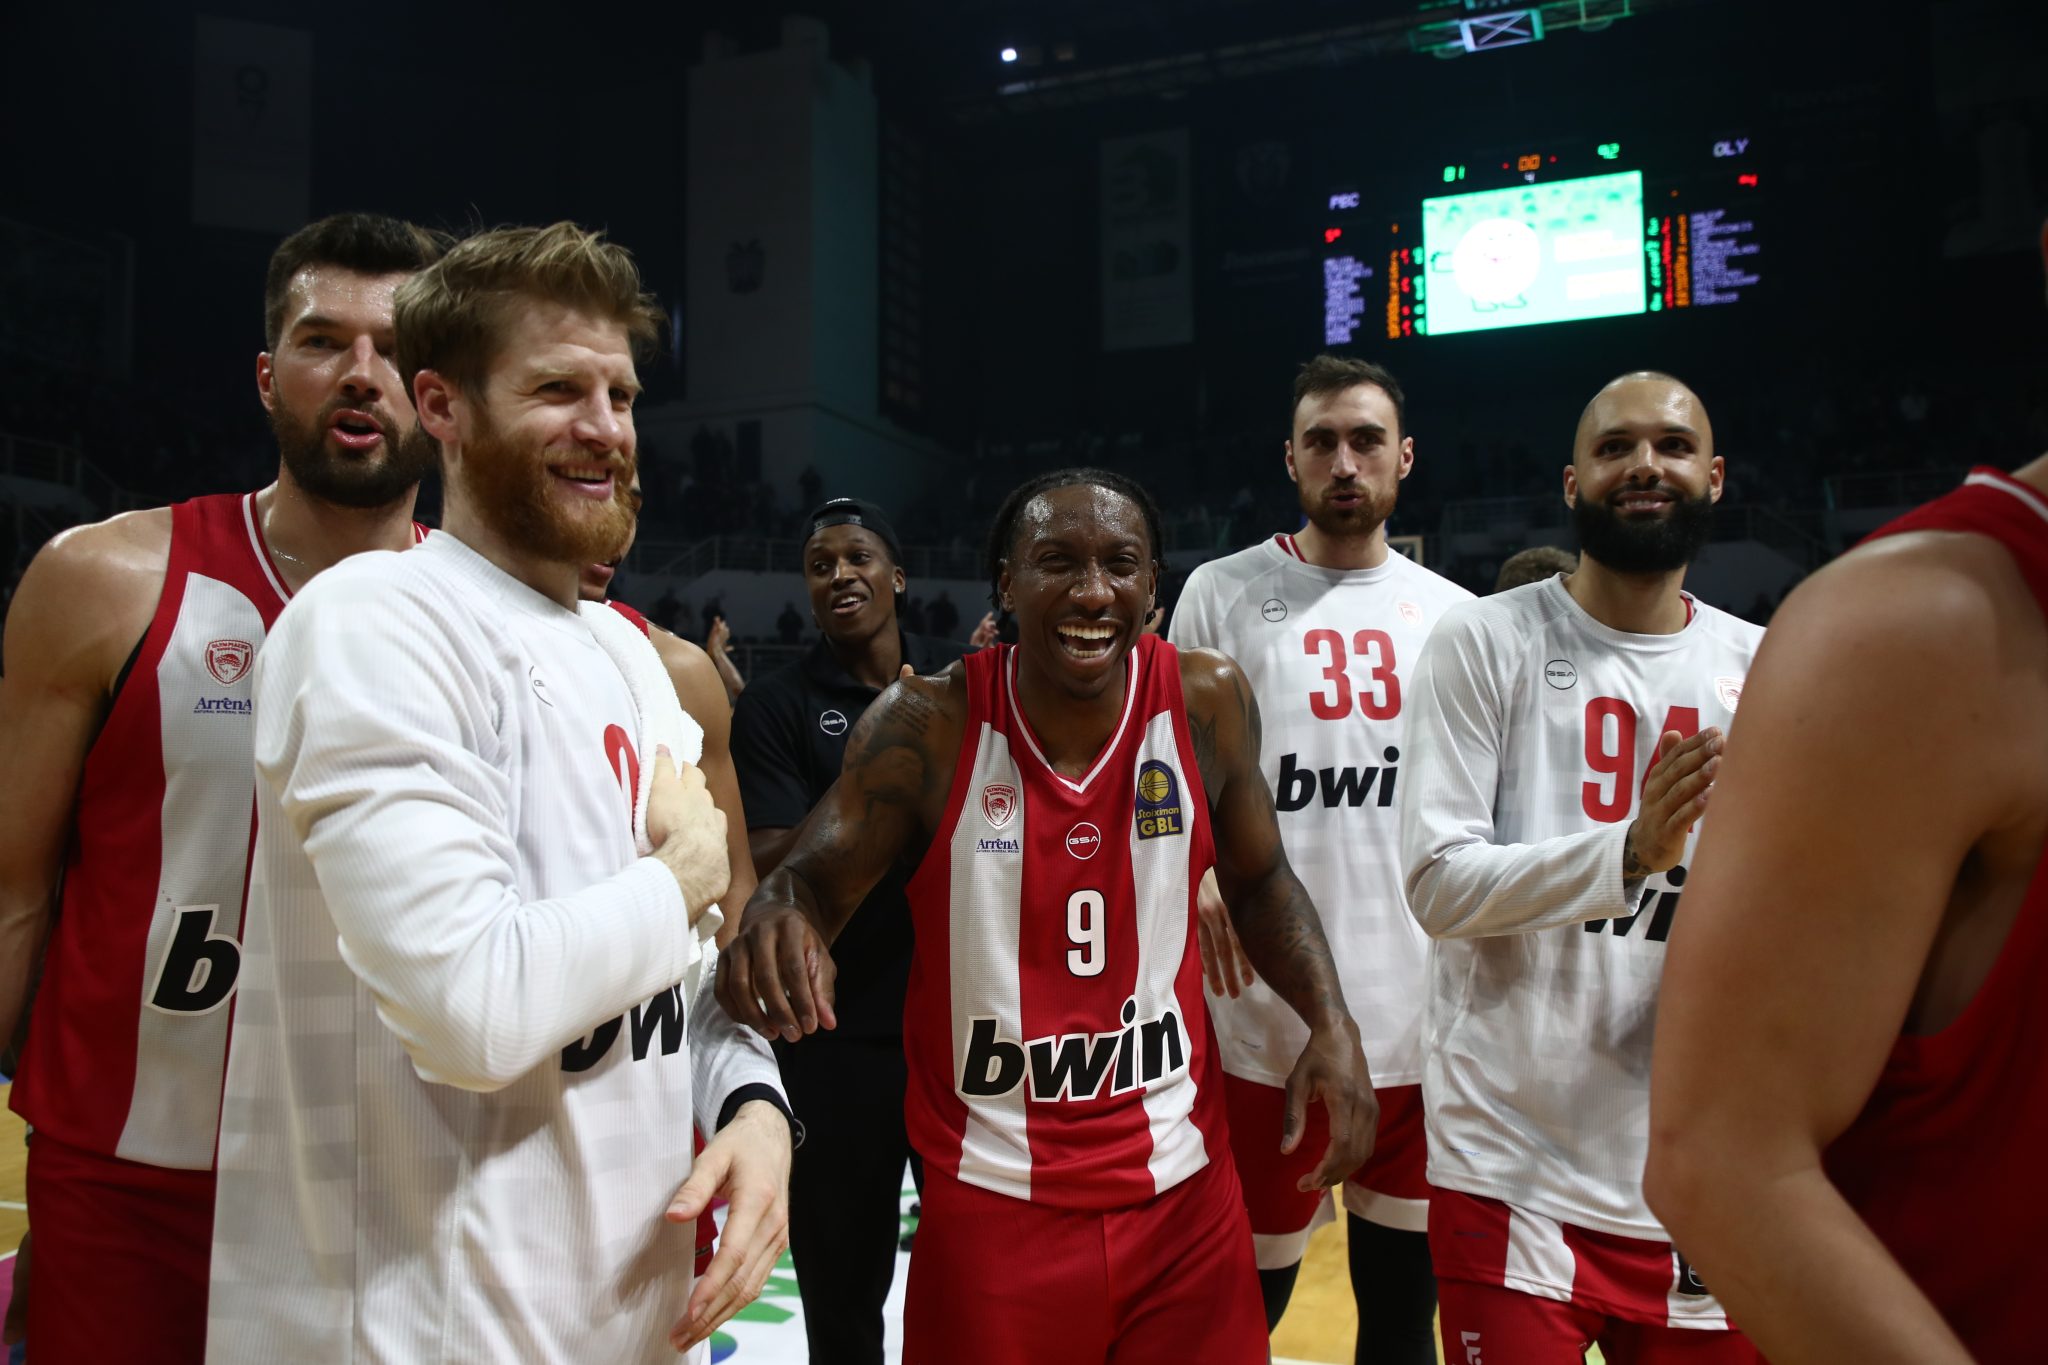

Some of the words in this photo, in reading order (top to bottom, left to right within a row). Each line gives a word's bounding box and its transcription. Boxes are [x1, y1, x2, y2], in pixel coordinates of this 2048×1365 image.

[1597, 143, 1619, 159] 92
[1713, 138, 1748, 157] OLY
[1518, 154, 1541, 171] 00
[1303, 629, 1402, 721] 33
[1276, 745, 1401, 812] bwi
[1137, 807, 1180, 819] Stoiximan
[1140, 816, 1180, 836] GBL
[1068, 835, 1099, 845] GSA
[1066, 889, 1106, 977] 9
[957, 996, 1187, 1101] bwin
